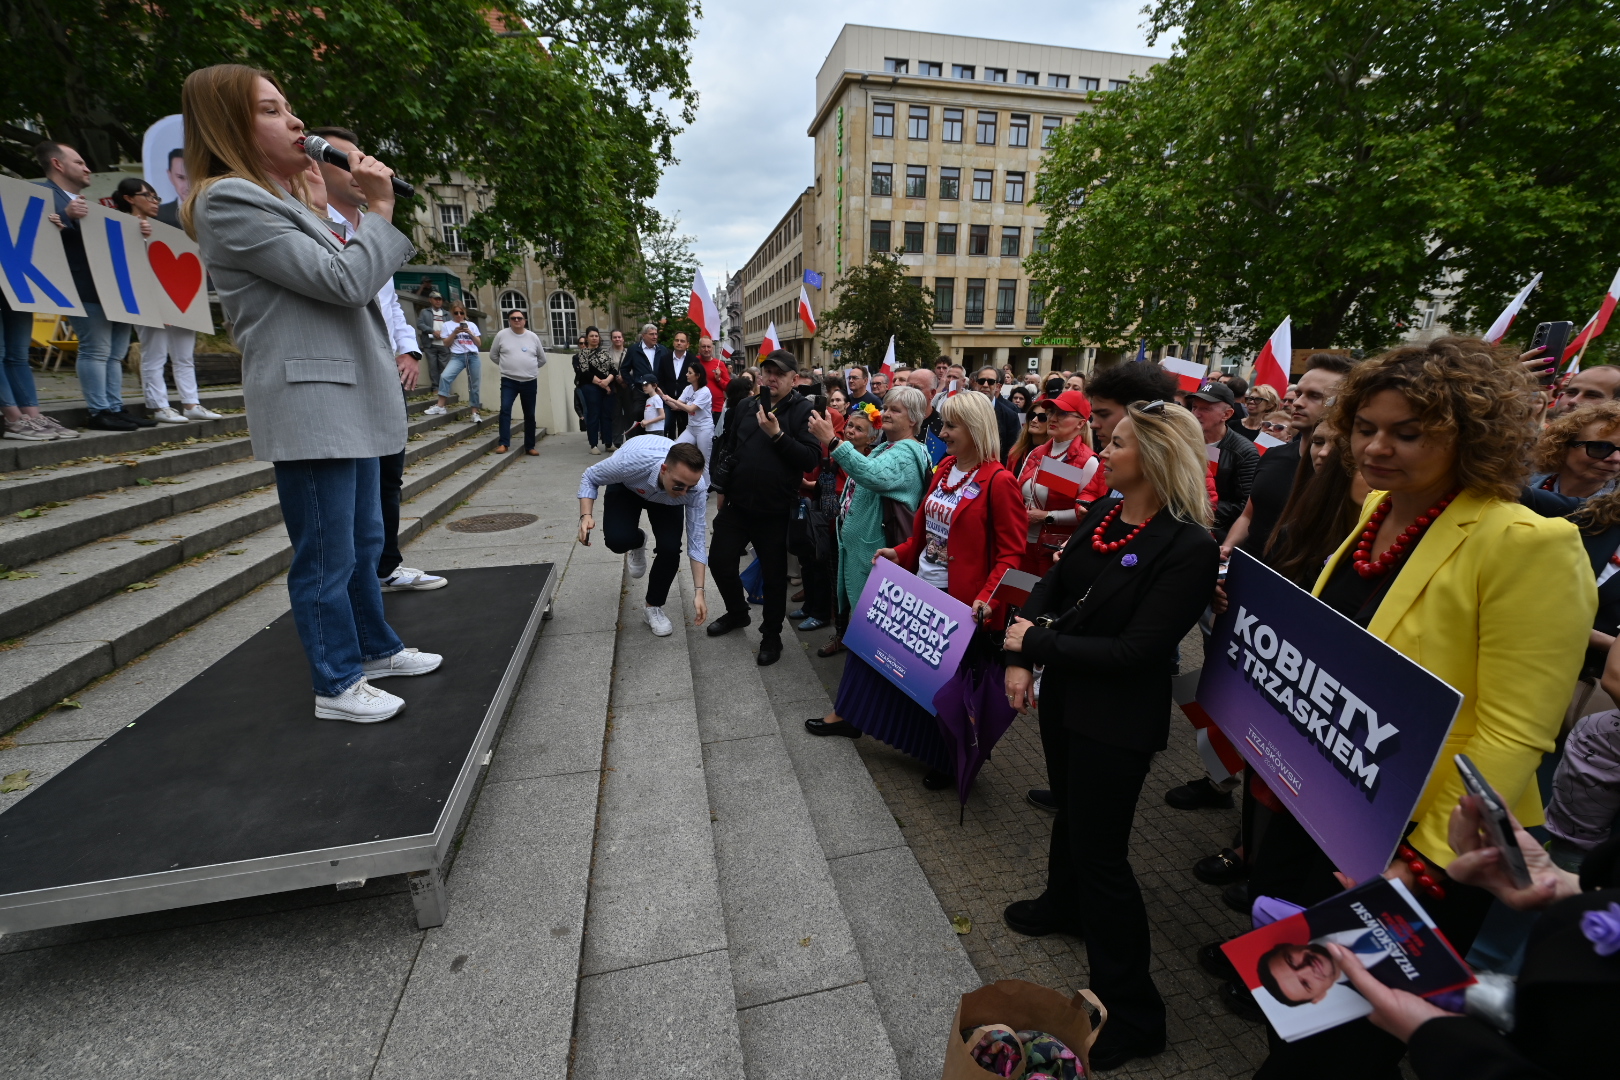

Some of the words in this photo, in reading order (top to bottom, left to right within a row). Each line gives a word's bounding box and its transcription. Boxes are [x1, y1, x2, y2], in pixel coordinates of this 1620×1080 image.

[866, 606, 943, 667] #TRZA2025
[872, 595, 889, 613] na
[890, 604, 950, 651] WYBORY
[877, 577, 958, 637] KOBIETY
[1233, 605, 1400, 755] KOBIETY
[1243, 648, 1381, 790] TRZASKIEM
[1247, 727, 1303, 791] TRZASKOWSKI
[1349, 901, 1421, 981] TRZASKOWSKI
